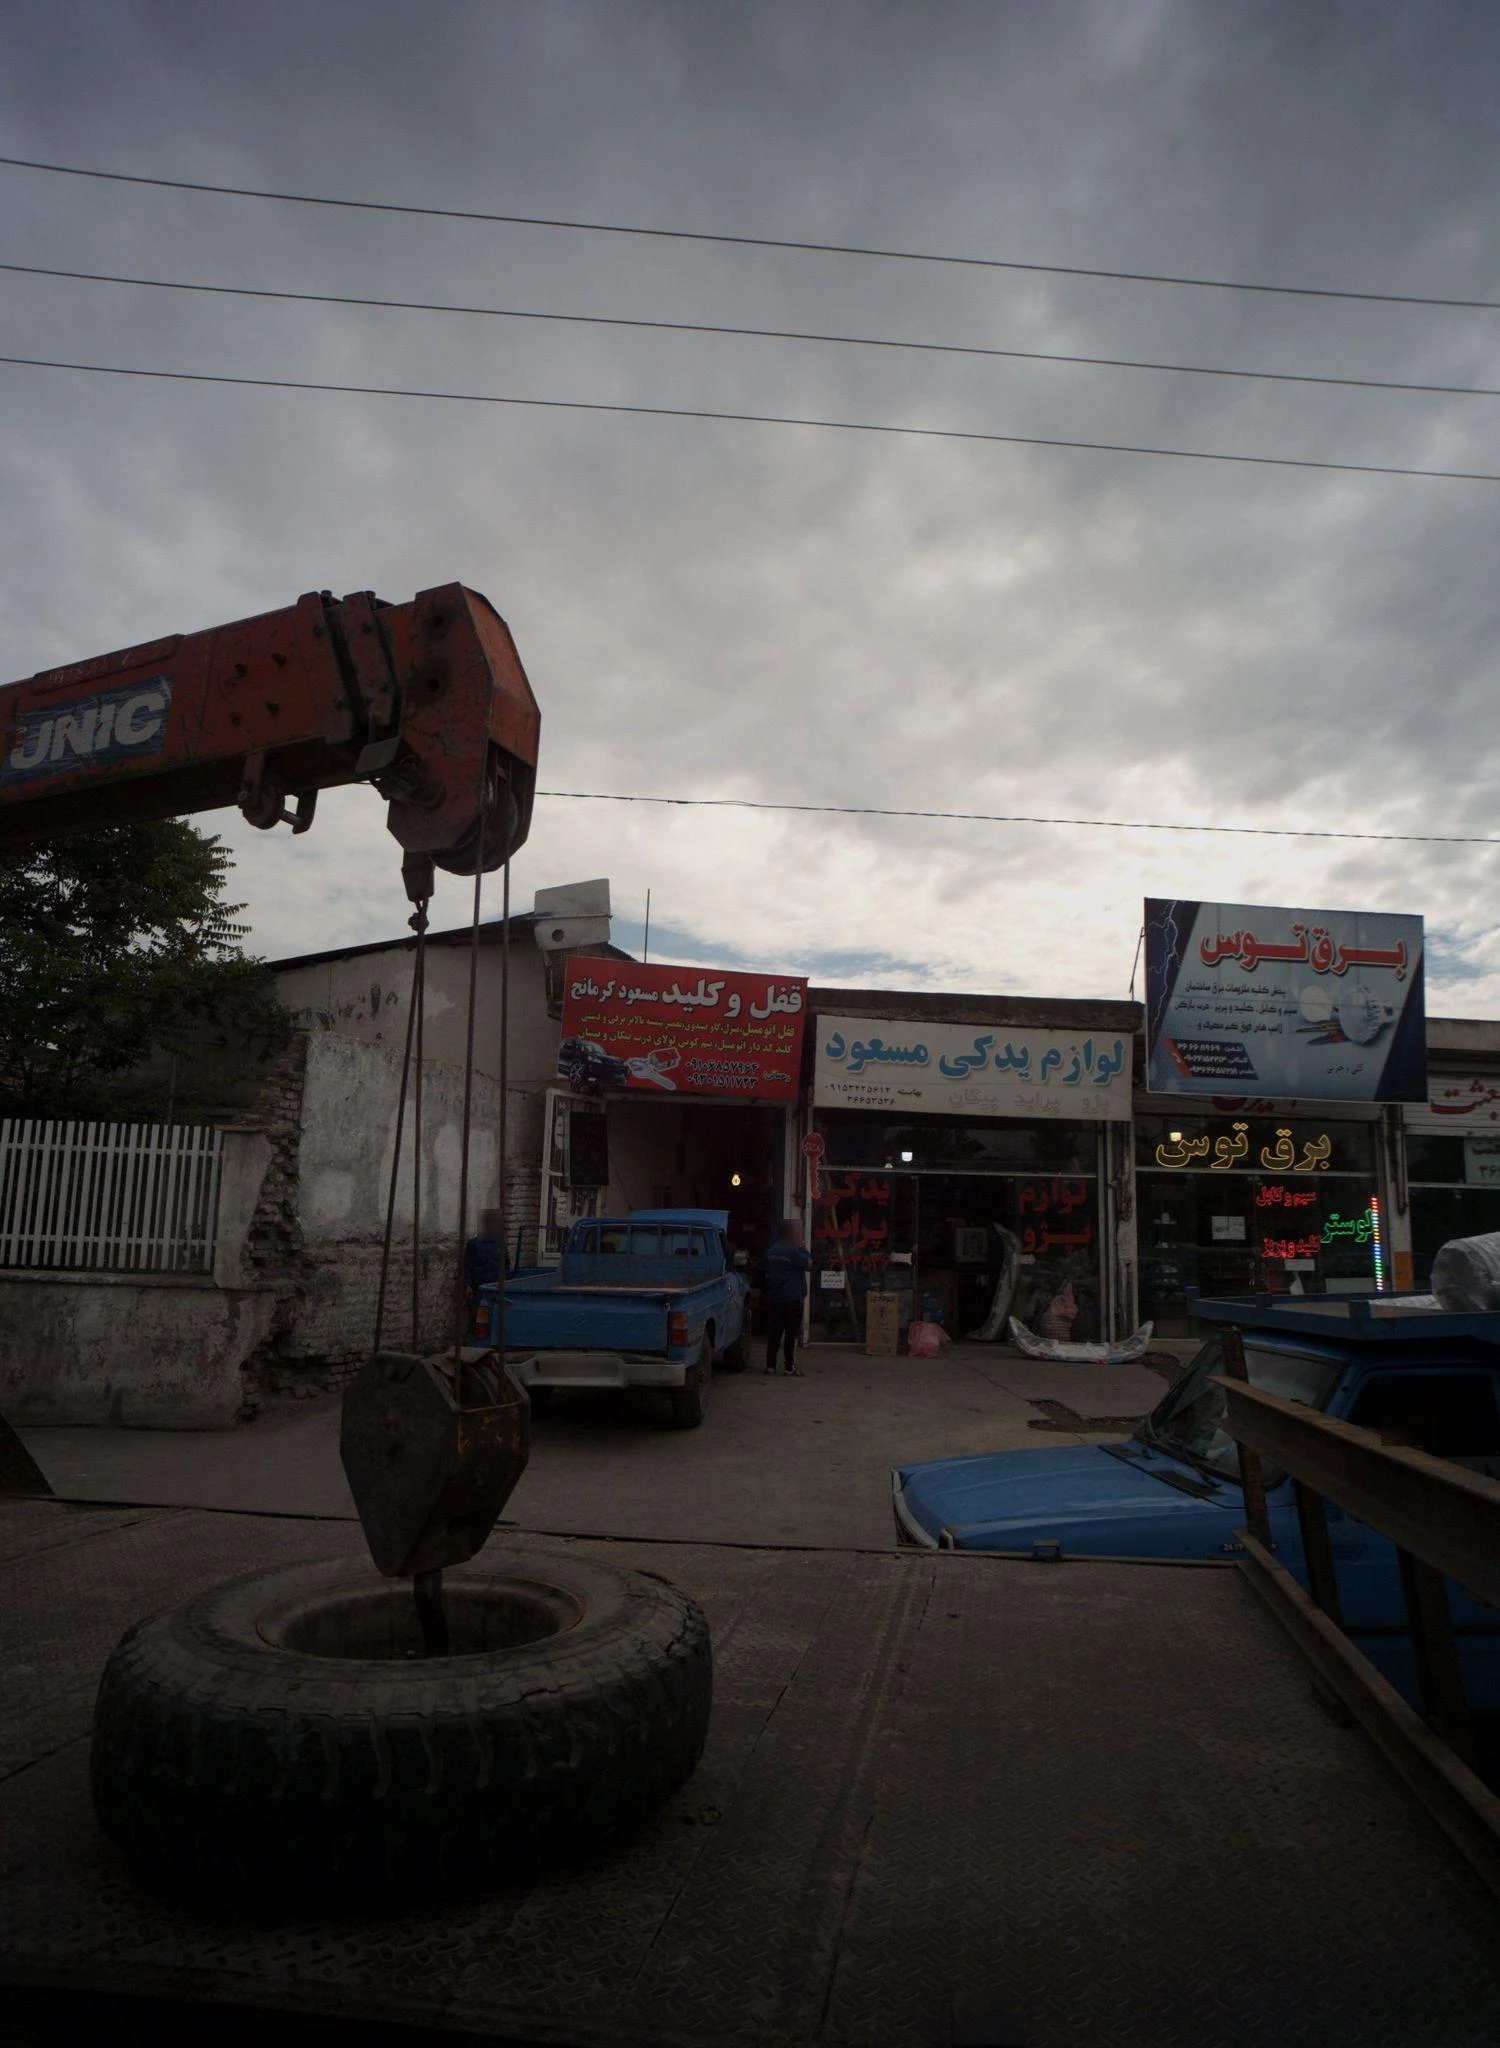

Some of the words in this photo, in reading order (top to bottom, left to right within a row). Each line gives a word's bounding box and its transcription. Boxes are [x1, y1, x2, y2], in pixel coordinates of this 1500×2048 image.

[1200, 922, 1308, 970] توس
[1309, 925, 1406, 979] برق
[619, 984, 659, 1005] مسعود
[662, 979, 726, 1012] کلید
[723, 992, 741, 1017] و
[750, 984, 802, 1018] قفل
[777, 1023, 795, 1039] قفل
[776, 1044, 793, 1056] کلید
[824, 1030, 930, 1073] مسعود
[938, 1033, 1030, 1081] یدکی
[1040, 1037, 1126, 1086] لوازم
[1155, 1121, 1250, 1169] توس
[1261, 1127, 1332, 1171] برق
[814, 1171, 891, 1207] یدکی
[1018, 1176, 1088, 1214] لوازم
[1256, 1185, 1284, 1207] کابل
[1283, 1192, 1292, 1207] و
[1293, 1191, 1317, 1207] سیم
[814, 1209, 888, 1249] پراید
[1020, 1218, 1093, 1253] پژو
[1320, 1207, 1374, 1243] لوستر
[1262, 1237, 1286, 1259] پریز
[1287, 1241, 1295, 1258] و
[1296, 1234, 1321, 1256] کلید
